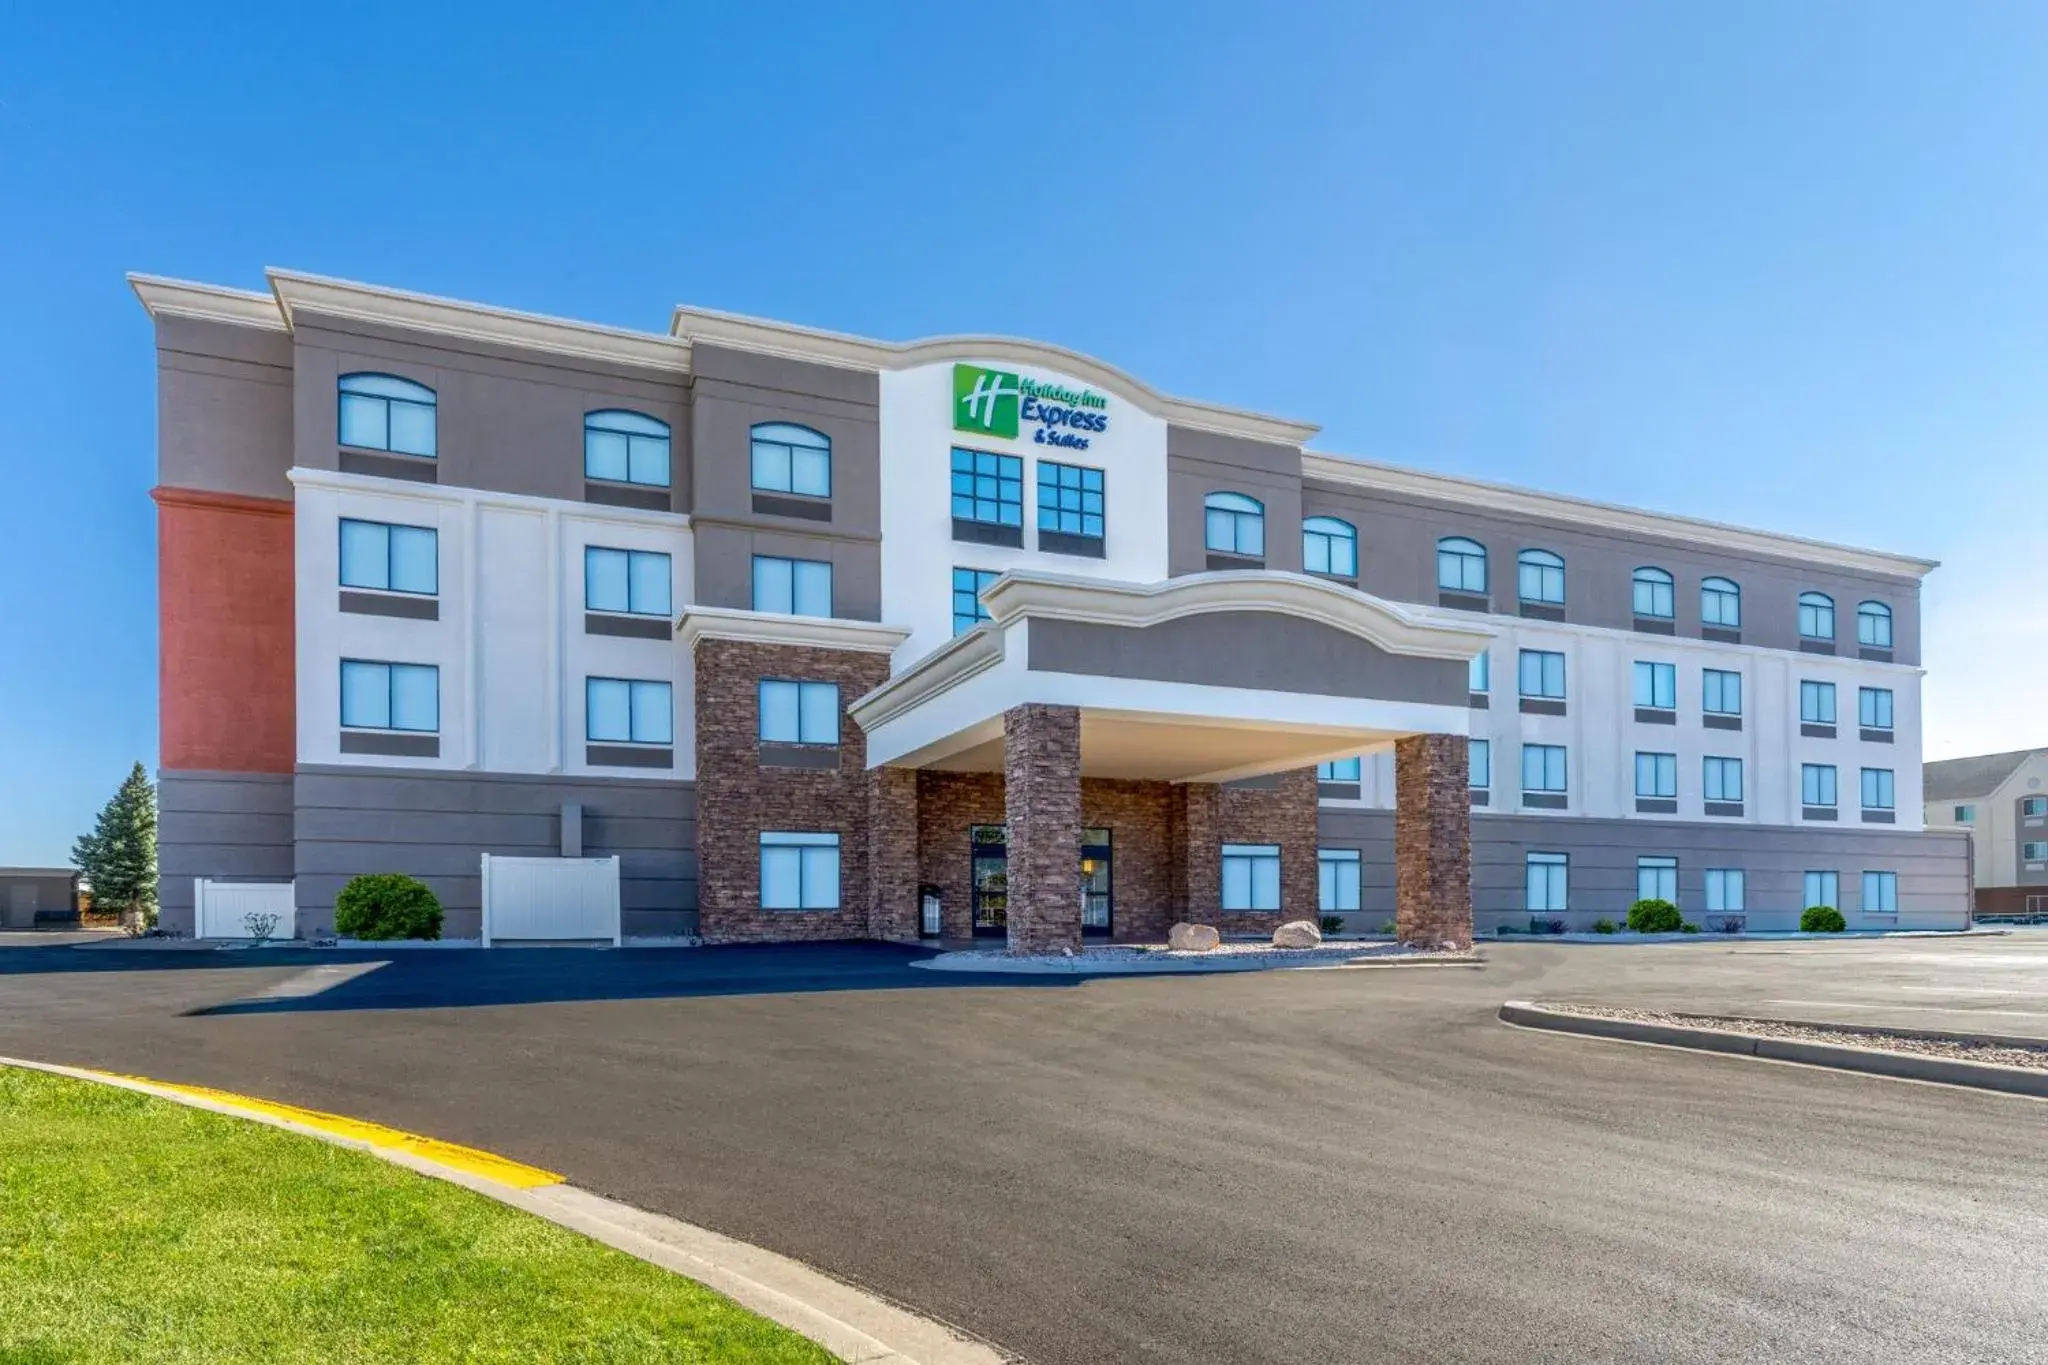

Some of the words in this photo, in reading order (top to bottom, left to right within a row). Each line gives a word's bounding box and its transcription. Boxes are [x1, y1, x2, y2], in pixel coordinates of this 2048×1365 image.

[962, 374, 1018, 429] H
[1020, 378, 1078, 407] Holiday
[1081, 389, 1107, 410] Inn
[1021, 396, 1108, 432] Express
[1034, 428, 1045, 444] &
[1047, 430, 1089, 450] Suites
